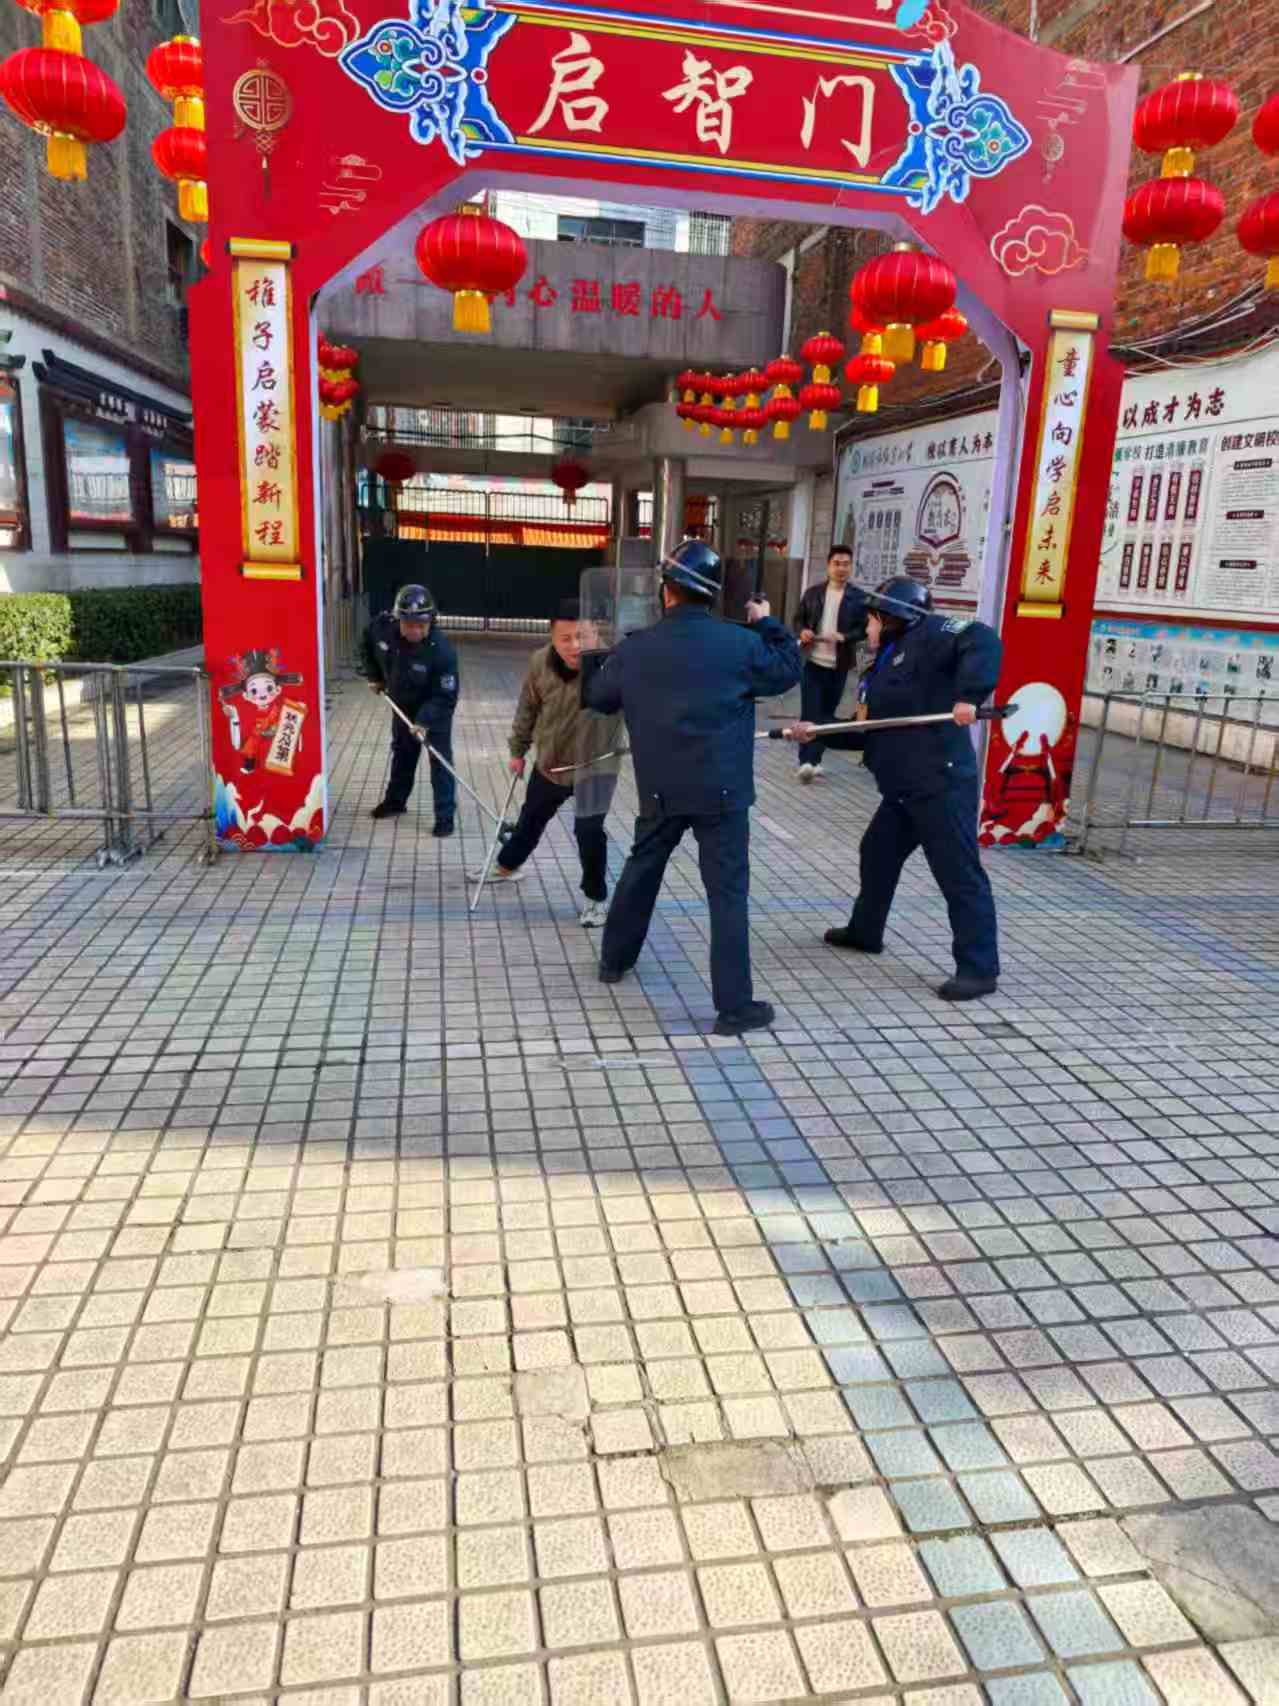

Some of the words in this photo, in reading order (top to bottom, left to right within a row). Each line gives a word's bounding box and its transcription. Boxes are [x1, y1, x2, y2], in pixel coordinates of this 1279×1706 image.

[527, 33, 875, 168] 启智门
[246, 279, 285, 546] 稚子启蒙踏新程
[1036, 348, 1080, 585] 童心向学启未来
[1122, 387, 1225, 430] 以成才为志
